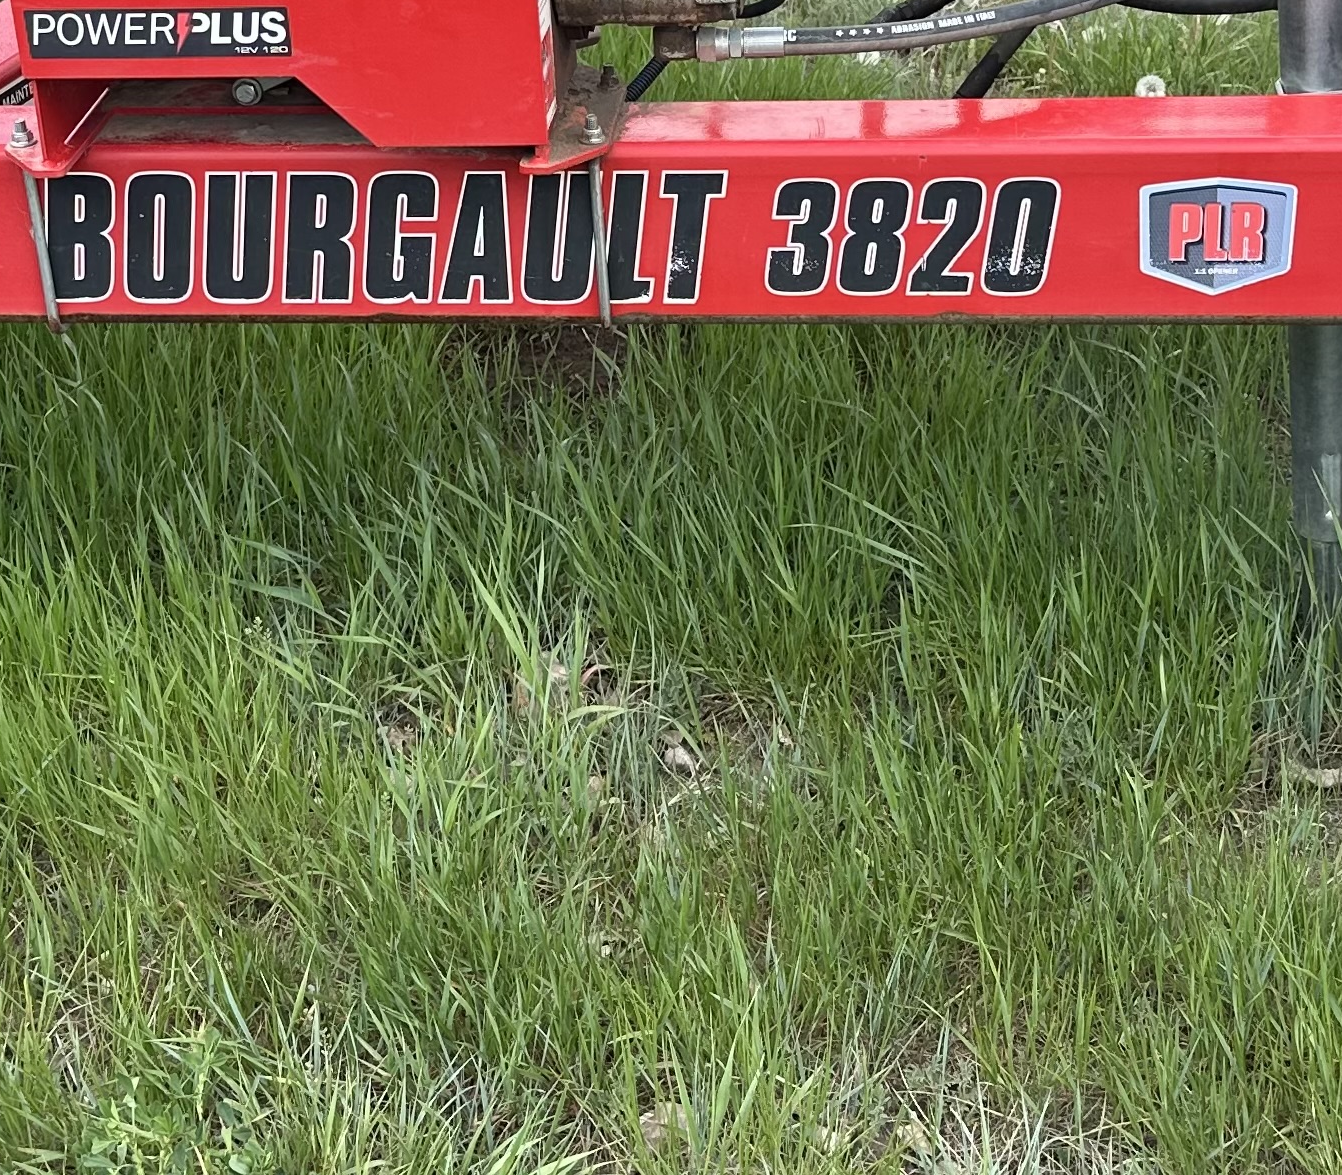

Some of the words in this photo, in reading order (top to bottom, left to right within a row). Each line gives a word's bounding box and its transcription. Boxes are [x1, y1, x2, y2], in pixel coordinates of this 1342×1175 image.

[262, 45, 288, 54] 120
[3, 80, 35, 105] MAINTE
[45, 171, 726, 305] BOURGAULT
[766, 177, 1060, 296] 3820
[1169, 202, 1265, 262] PLR
